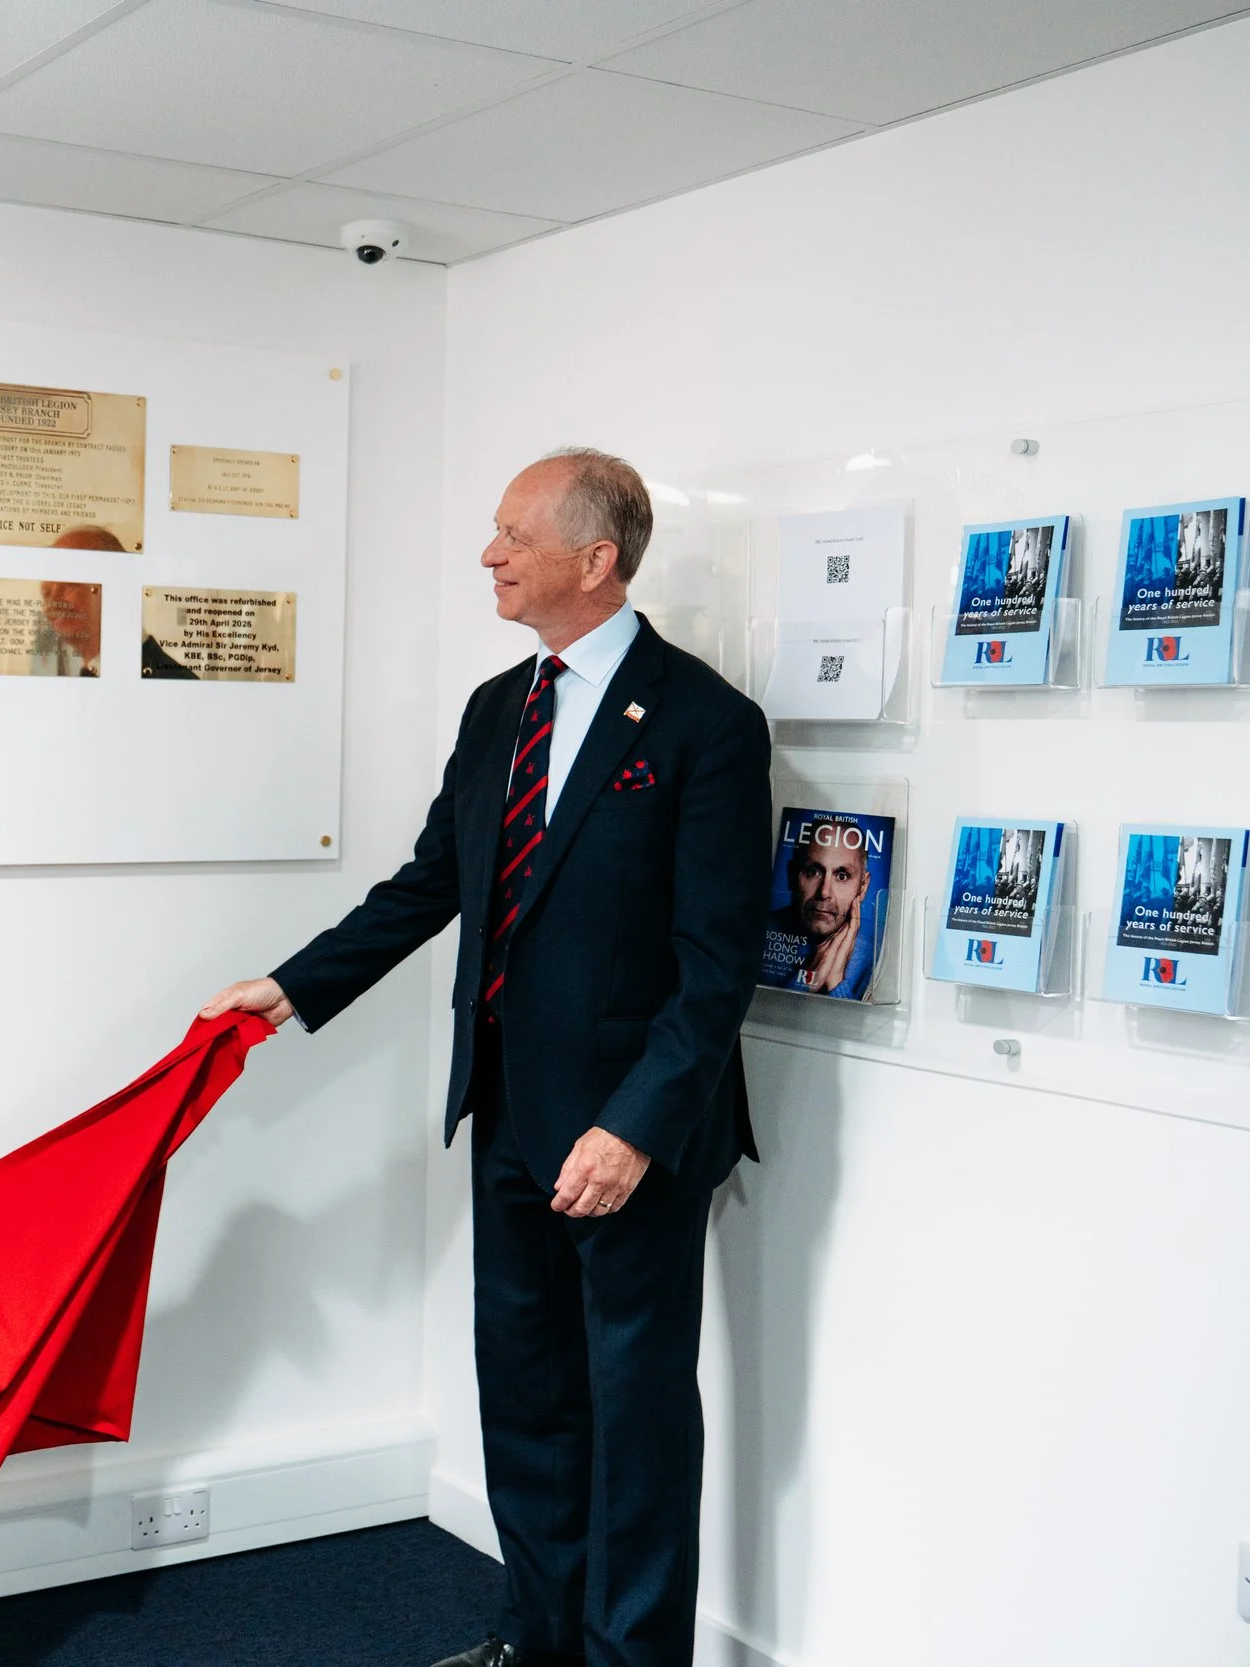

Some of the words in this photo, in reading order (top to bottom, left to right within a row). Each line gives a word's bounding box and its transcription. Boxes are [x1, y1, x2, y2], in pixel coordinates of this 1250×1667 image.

[1, 395, 39, 407] BRITISH
[41, 399, 78, 411] LEGION
[21, 407, 61, 419] BRANCH
[37, 418, 57, 428] 1922
[31, 438, 42, 446] THE
[19, 521, 35, 532] NOT
[40, 522, 62, 534] SELF
[1137, 588, 1161, 599] One
[1165, 584, 1210, 597] hundred
[6, 598, 22, 607] WAS
[164, 594, 183, 603] This
[184, 595, 209, 604] office
[211, 597, 228, 605] was
[230, 597, 277, 607] refurbished
[971, 597, 991, 607] One
[995, 594, 1035, 606] hundred
[1128, 601, 1158, 614] years
[1161, 599, 1174, 610] of
[1176, 598, 1215, 609] service
[13, 608, 26, 617] THE
[186, 607, 202, 615] and
[204, 608, 242, 618] reopened
[963, 609, 988, 620] years
[991, 608, 1001, 617] of
[1003, 607, 1037, 616] service
[4, 618, 31, 627] JERSEY
[189, 618, 208, 626] 29th
[210, 618, 230, 629] April
[0, 627, 10, 635] ON
[12, 628, 26, 637] THE
[183, 629, 194, 639] by
[196, 630, 210, 639] His
[212, 630, 257, 641] Excellency
[159, 640, 179, 648] Vice
[181, 640, 213, 649] Admiral
[215, 641, 227, 650] Sir
[229, 642, 260, 653] Jeremy
[204, 663, 242, 673] Governor
[243, 664, 253, 673] of
[254, 665, 282, 676] Jersey
[813, 813, 833, 822] ROYAL
[835, 815, 858, 824] BRITISH
[783, 820, 884, 853] LEGION
[962, 892, 982, 903] One
[985, 894, 1025, 907] hundred
[953, 904, 978, 915] years
[981, 906, 992, 916] of
[993, 908, 1029, 920] service
[1134, 906, 1159, 918] One
[1163, 908, 1209, 922] hundred
[1125, 919, 1155, 931] years
[1159, 921, 1172, 931] of
[1174, 925, 1215, 936] service
[768, 942, 798, 955] LONG
[763, 952, 806, 966] HADOW
